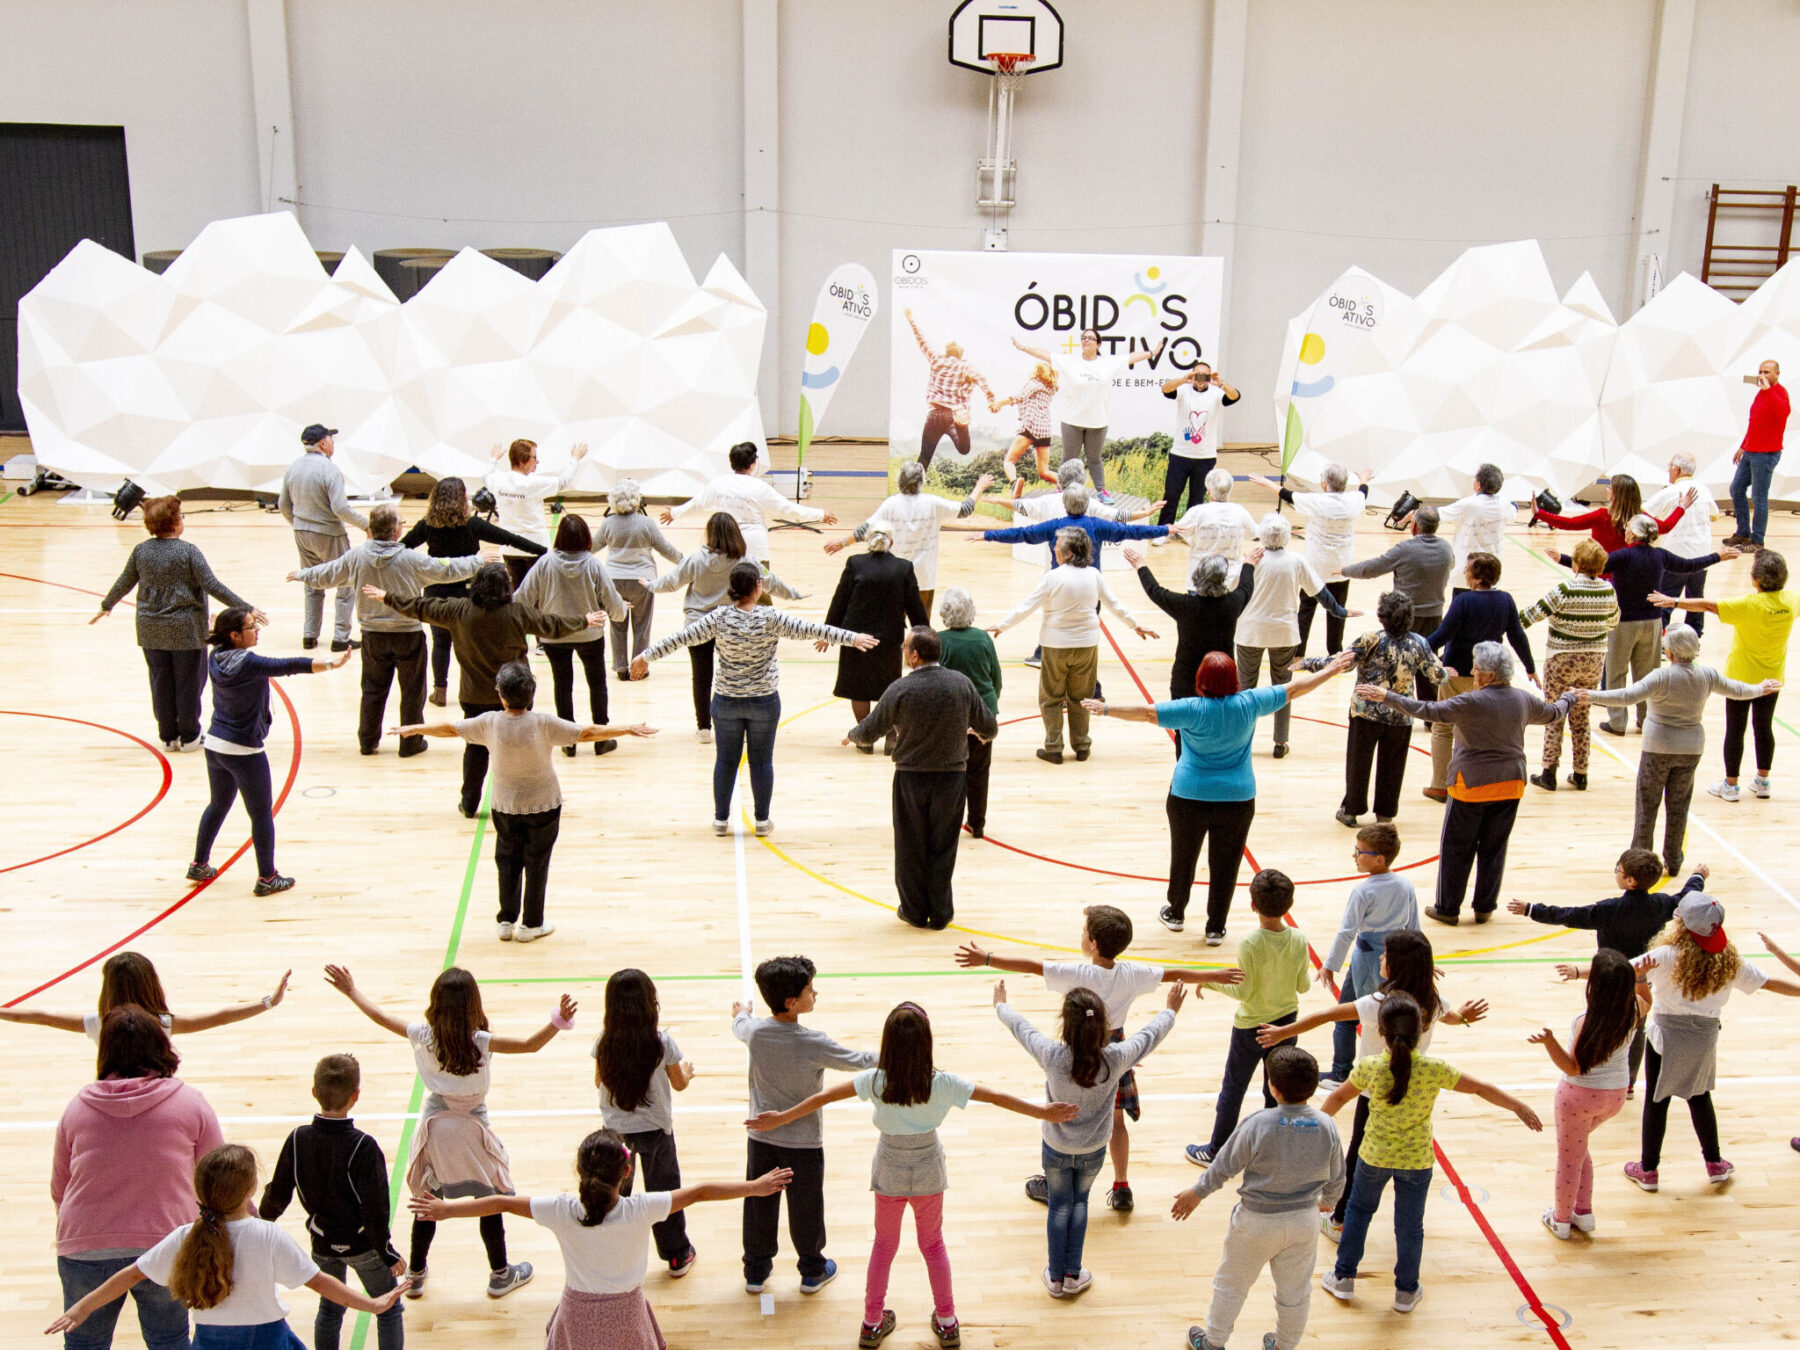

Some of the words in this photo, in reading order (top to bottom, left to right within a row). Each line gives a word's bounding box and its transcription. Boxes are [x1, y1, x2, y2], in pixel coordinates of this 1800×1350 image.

[842, 301, 872, 317] ATIVO
[1342, 311, 1376, 327] ATIVO
[1098, 336, 1202, 370] TIVO
